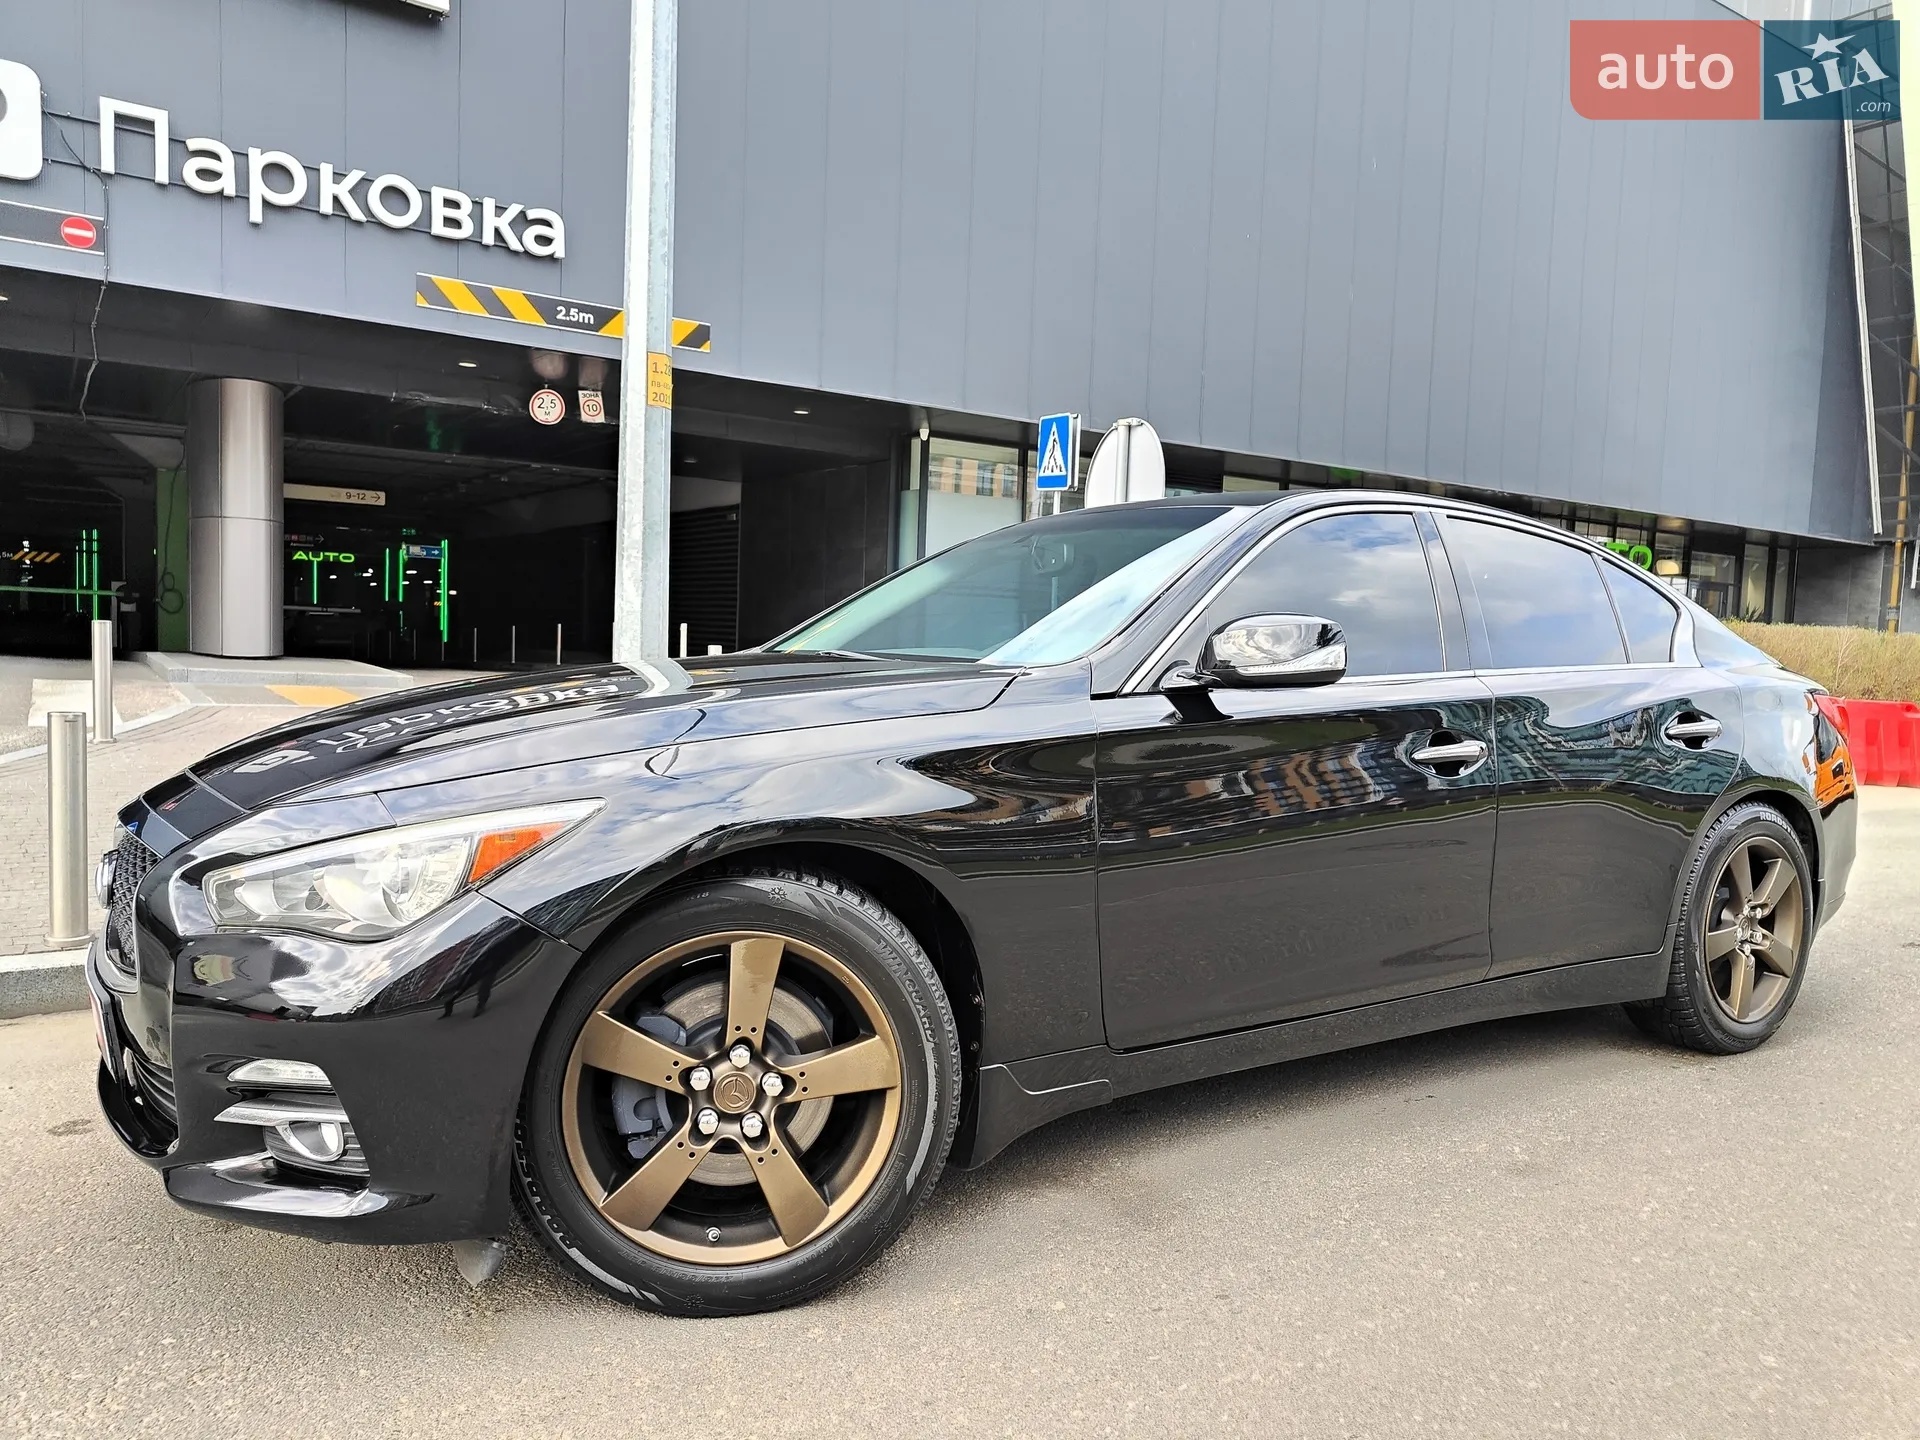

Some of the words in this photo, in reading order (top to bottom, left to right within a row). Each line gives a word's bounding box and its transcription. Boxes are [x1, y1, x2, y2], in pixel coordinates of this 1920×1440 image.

[99, 95, 566, 260] Парковка
[555, 305, 595, 325] 2.5m
[586, 403, 598, 413] 10
[345, 491, 367, 501] 9-12
[292, 550, 355, 563] AUTO
